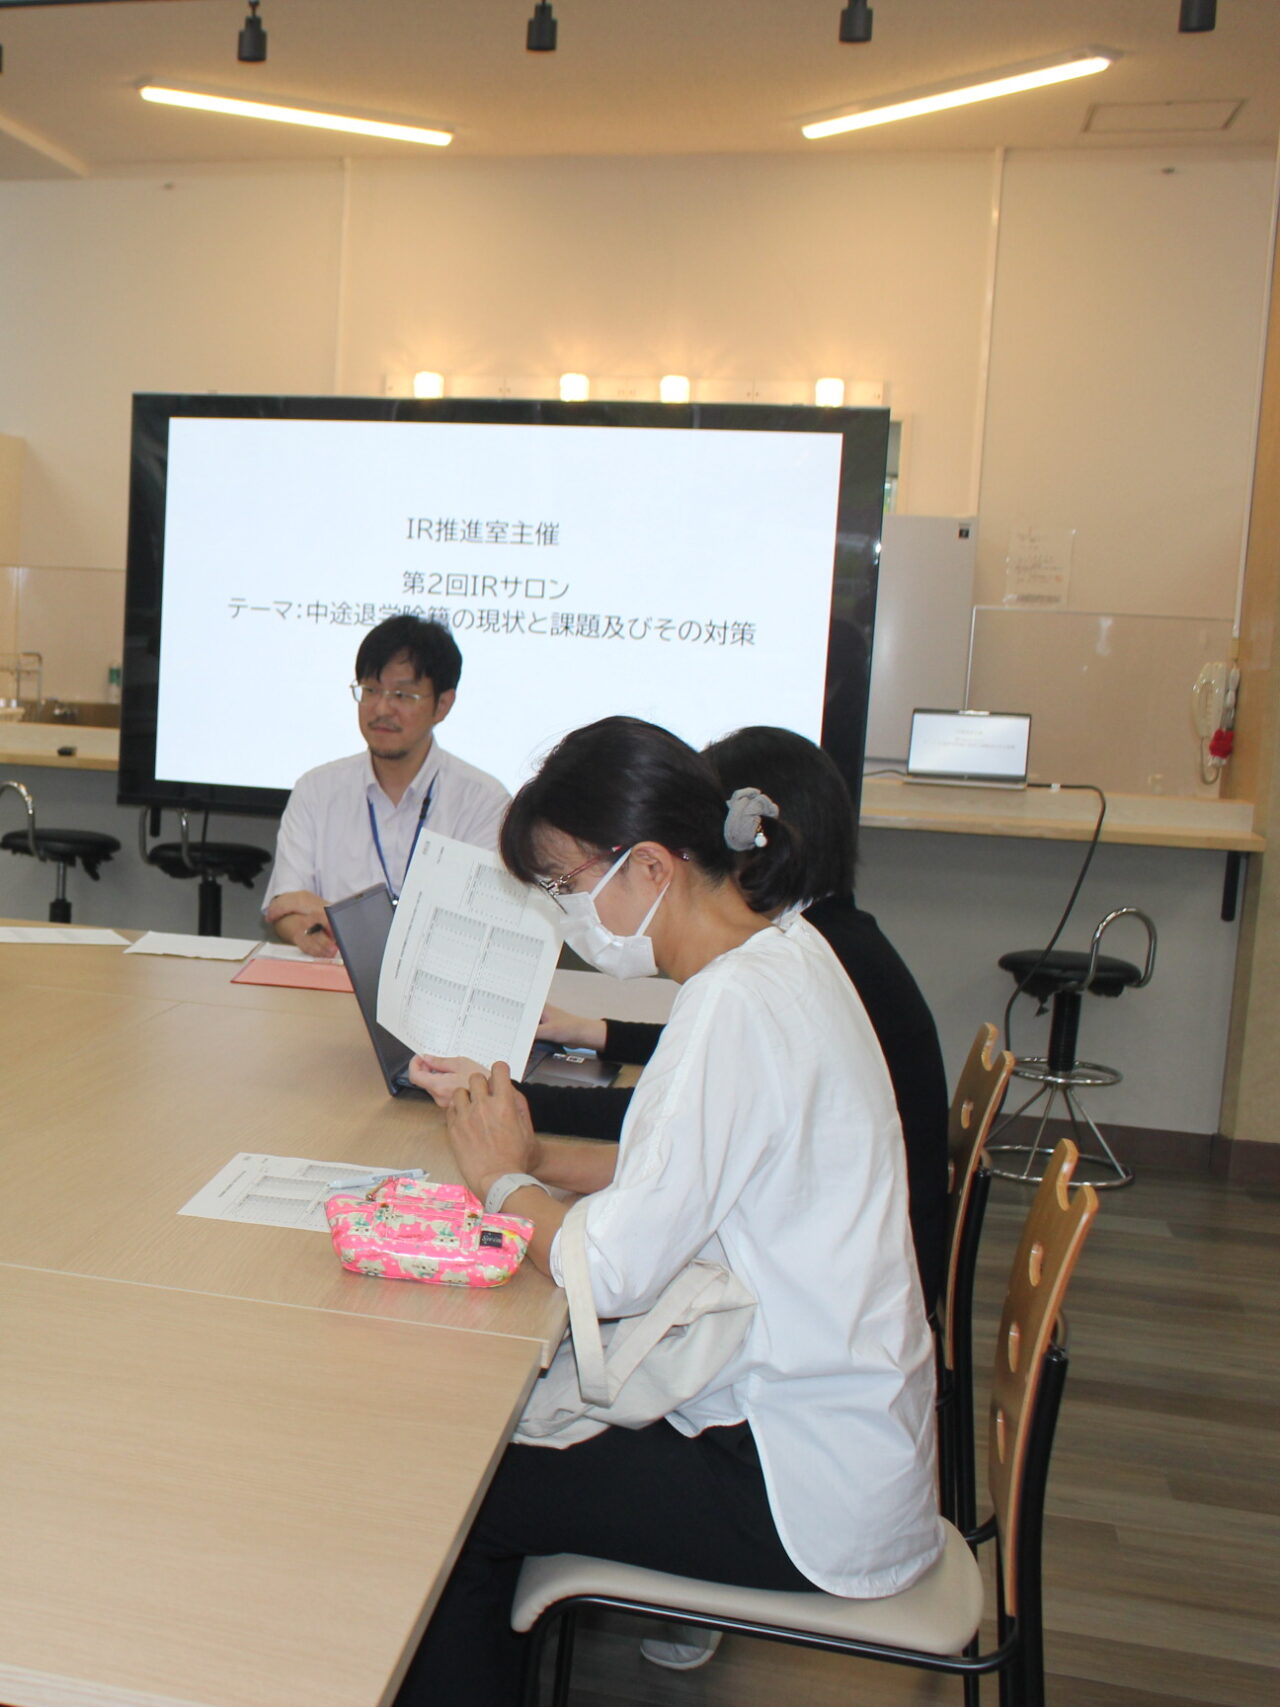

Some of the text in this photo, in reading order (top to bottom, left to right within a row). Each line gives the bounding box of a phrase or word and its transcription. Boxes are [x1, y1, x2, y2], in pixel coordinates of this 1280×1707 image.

[406, 517, 561, 546] IR推進室主催
[402, 571, 571, 600] 第2回IRサロン
